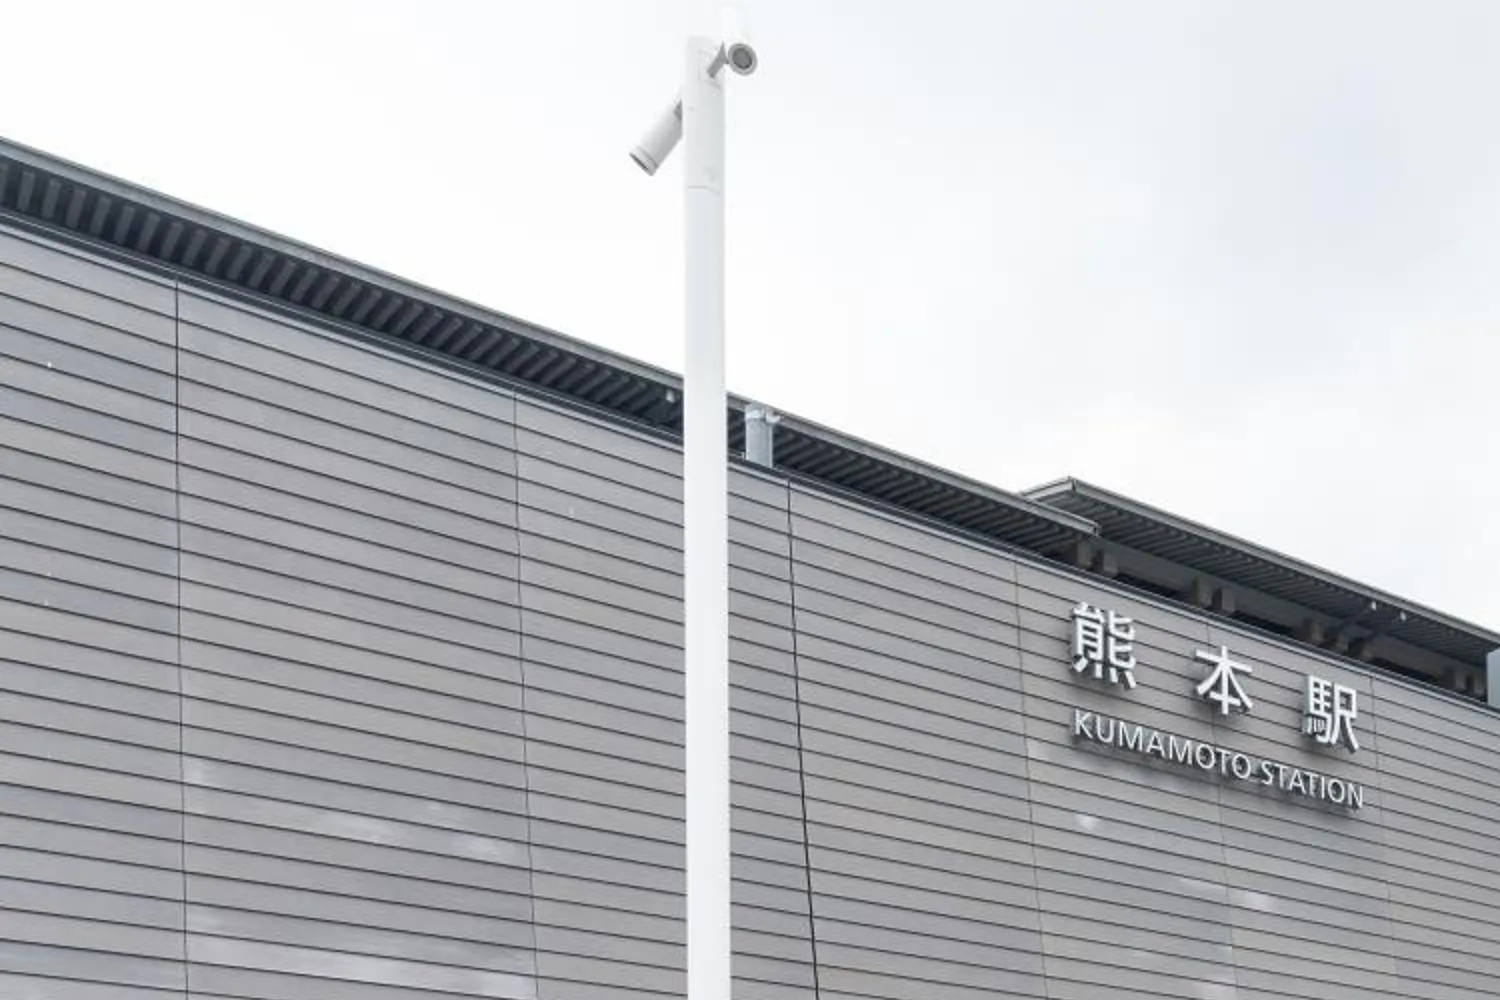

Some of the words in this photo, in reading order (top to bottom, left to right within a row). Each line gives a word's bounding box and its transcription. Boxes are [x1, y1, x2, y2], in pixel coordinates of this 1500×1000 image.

[1072, 602, 1360, 751] 熊本駅
[1074, 709, 1252, 780] KUMAMOTO
[1261, 761, 1363, 809] STATION
